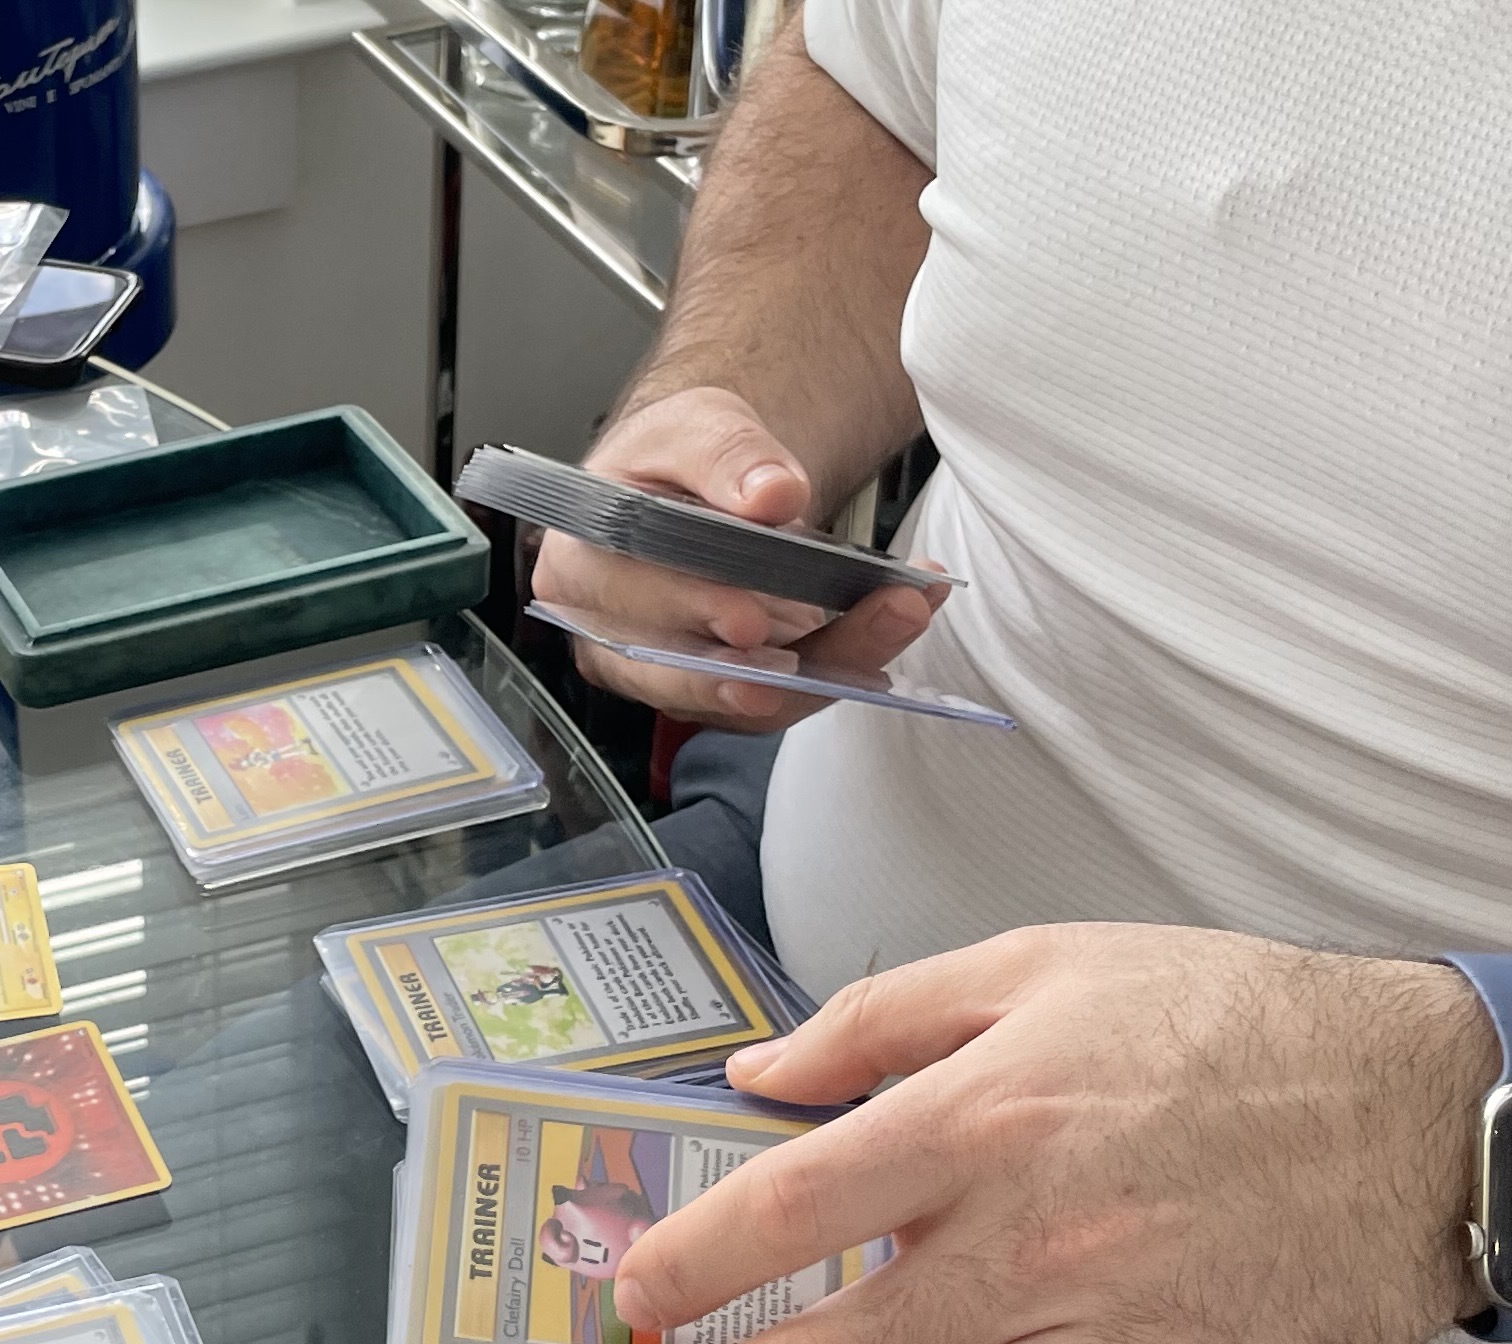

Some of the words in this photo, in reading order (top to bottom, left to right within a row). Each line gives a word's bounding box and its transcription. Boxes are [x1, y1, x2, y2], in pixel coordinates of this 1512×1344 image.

[163, 747, 215, 804] TRAINER
[397, 971, 449, 1042] TRAINER
[515, 1144, 531, 1163] 10
[516, 1117, 533, 1145] HP
[469, 1161, 500, 1282] TRAINER
[506, 1235, 525, 1272] Doll
[502, 1274, 526, 1340] Clefairy
